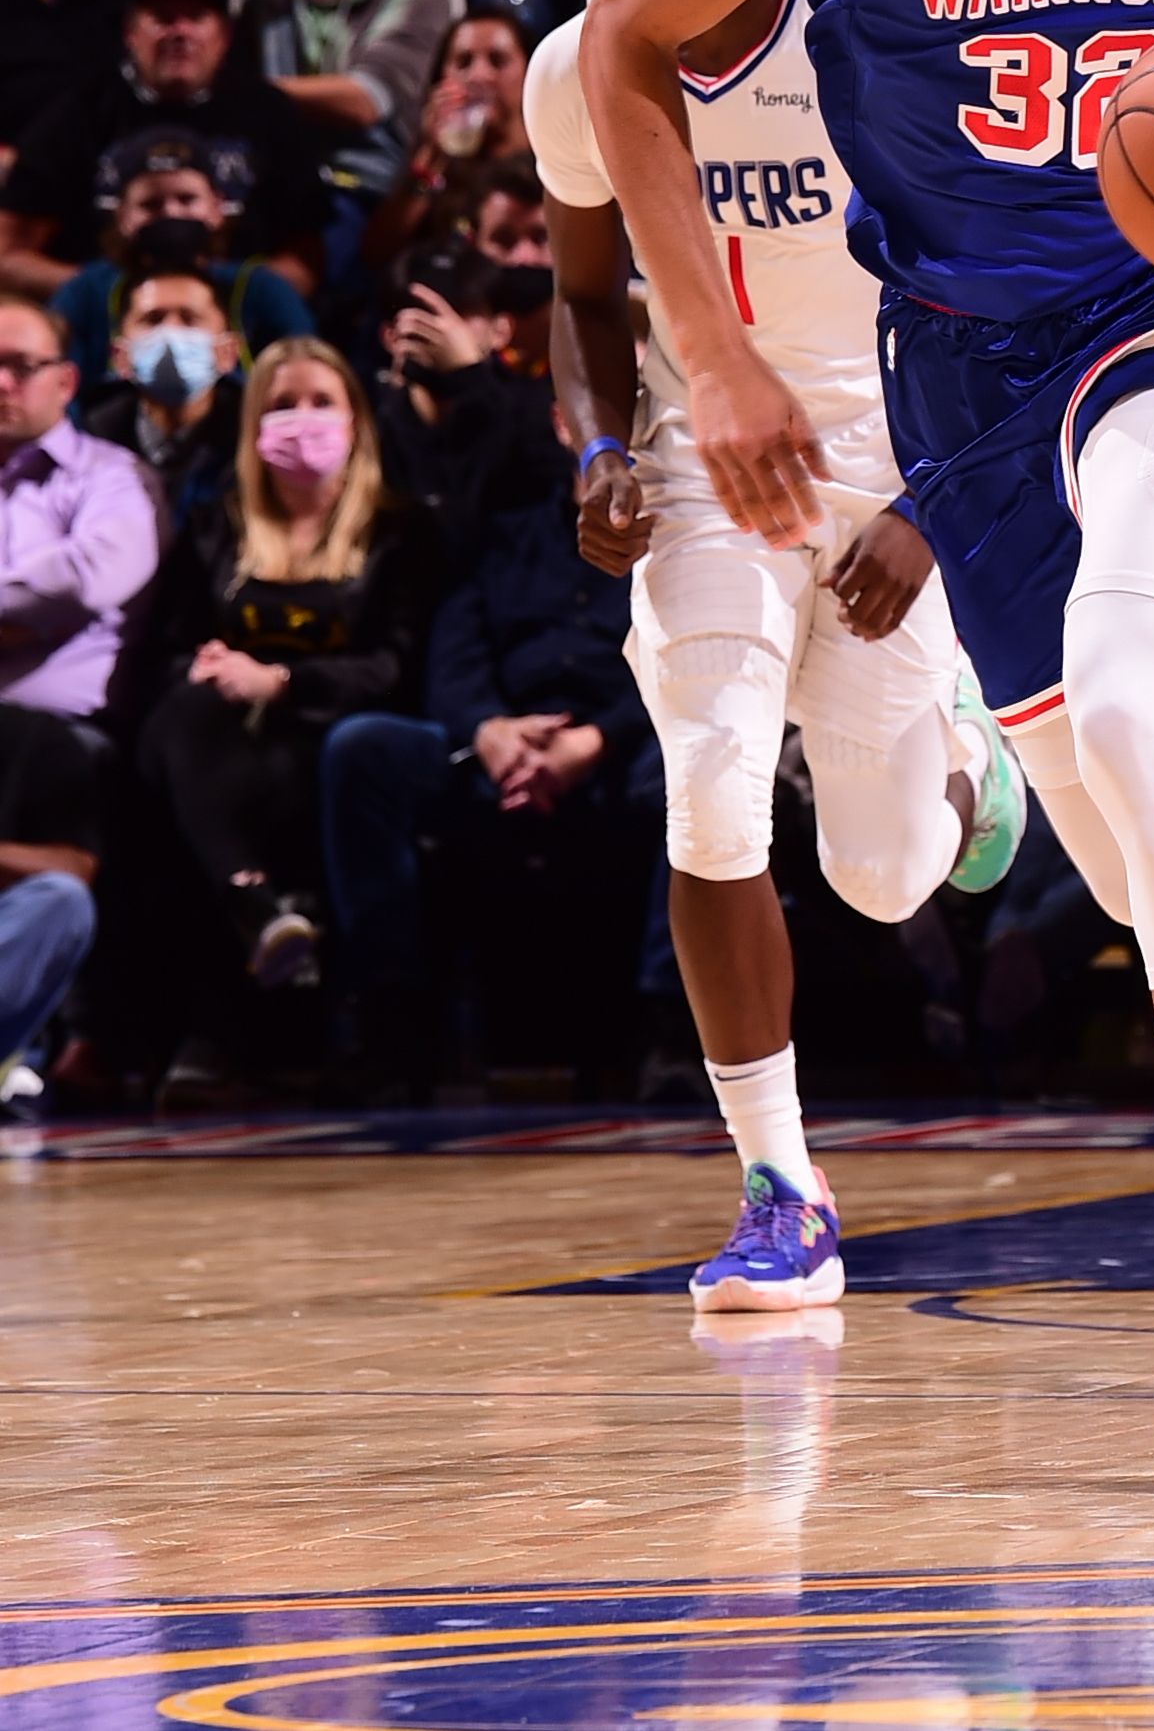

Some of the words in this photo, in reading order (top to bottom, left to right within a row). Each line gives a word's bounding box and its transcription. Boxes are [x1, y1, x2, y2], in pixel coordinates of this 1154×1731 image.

[752, 86, 814, 113] honey
[697, 156, 833, 230] PERS
[728, 235, 755, 326] 1
